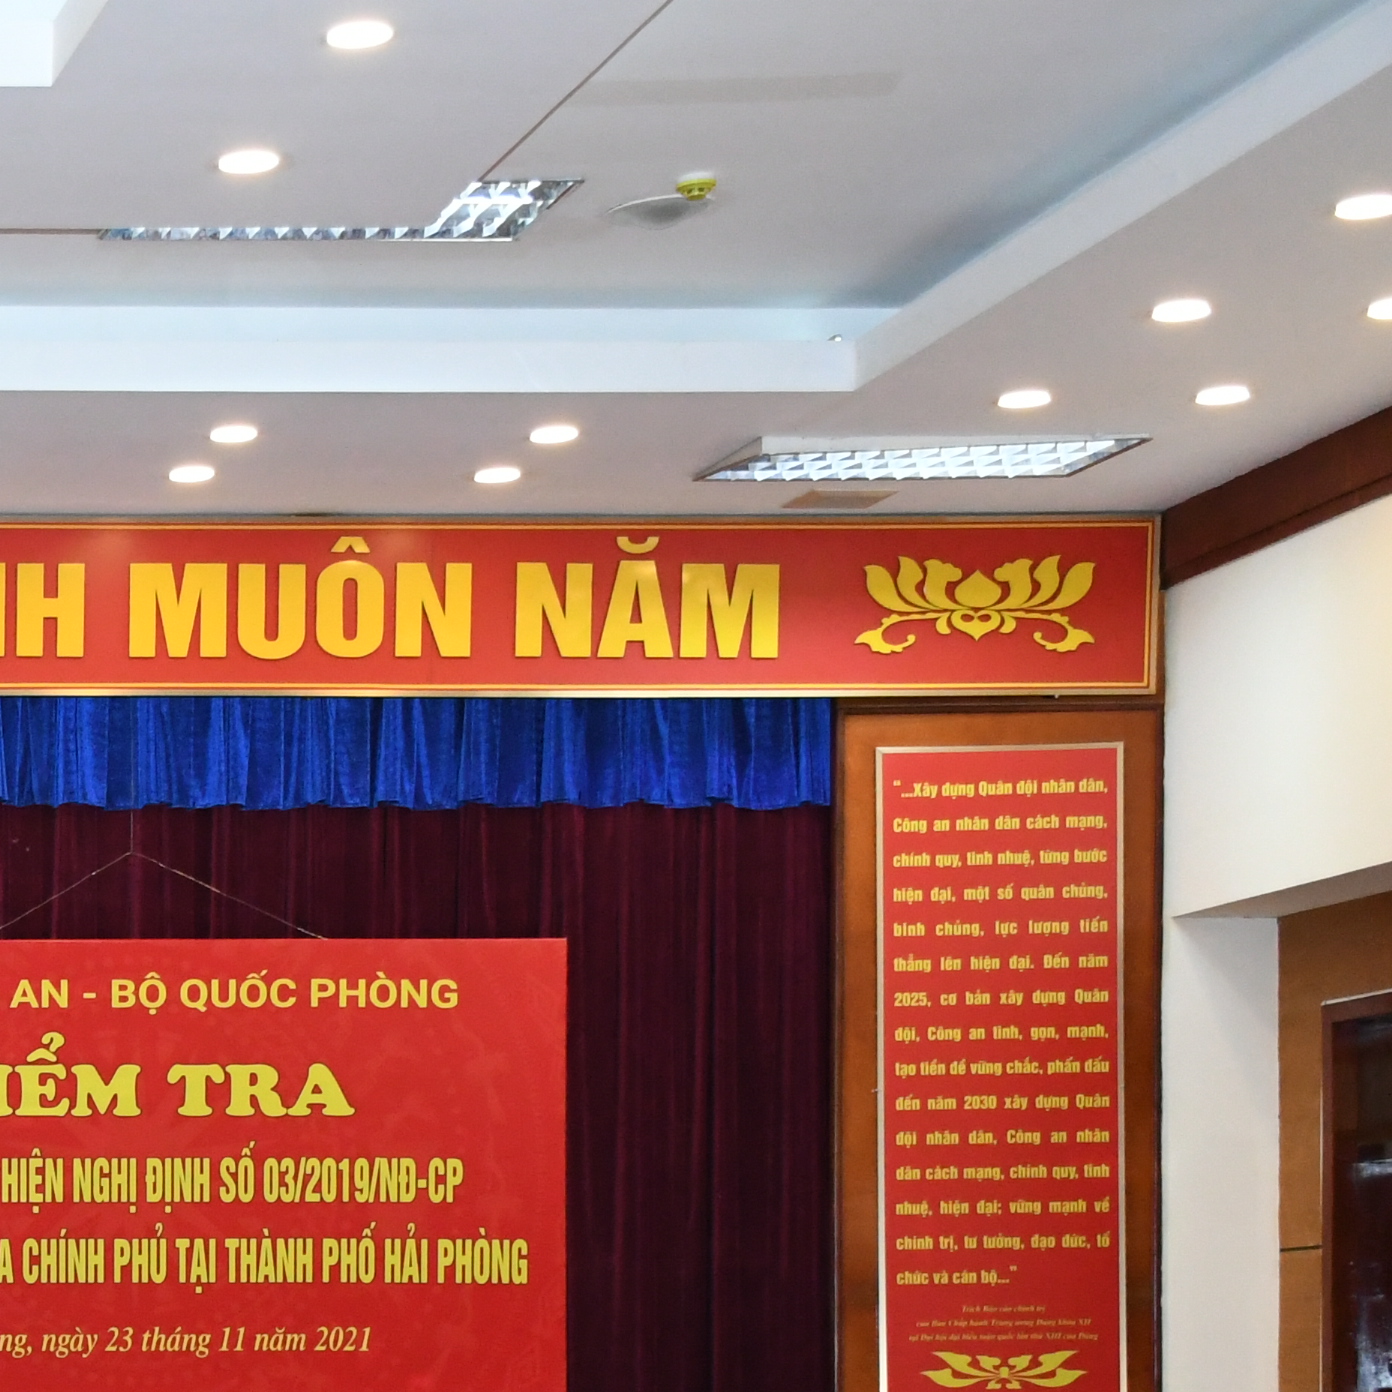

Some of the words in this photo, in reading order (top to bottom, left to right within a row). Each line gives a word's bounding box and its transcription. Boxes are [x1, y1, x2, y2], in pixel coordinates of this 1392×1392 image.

[129, 537, 472, 659] MUÔN
[515, 537, 779, 658] NĂM
[979, 781, 1012, 796] Quân
[1042, 779, 1075, 793] nhân
[893, 818, 927, 833] Công
[933, 820, 950, 831] an
[956, 816, 989, 831] nhân
[995, 815, 1020, 830] dân
[1026, 814, 1059, 829] cách
[967, 851, 992, 865] tinh
[10, 979, 68, 1008] AN
[112, 972, 166, 1015] BỘ
[180, 970, 296, 1012] QUỐC
[311, 971, 458, 1008] PHÒNG
[894, 992, 931, 1007] 2025,
[1000, 990, 1023, 1005] xây
[1075, 989, 1109, 1004] Quân
[167, 1063, 355, 1116] TRA
[928, 1096, 956, 1110] năm
[964, 1095, 997, 1109] 2030
[1005, 1095, 1028, 1110] xây
[1076, 1094, 1110, 1109] Quân
[2, 1148, 63, 1213] HIỆN
[73, 1157, 136, 1213] NGHỊ
[145, 1158, 210, 1213] ĐỊNH
[220, 1141, 255, 1202] SỐ
[264, 1157, 463, 1203] 03/2019/NĐ-CP
[23, 1229, 104, 1284] CHÍNH
[114, 1223, 166, 1283] PHỦ
[175, 1238, 216, 1293] TẠI
[225, 1228, 313, 1283] THÀNH
[323, 1222, 376, 1283] PHỐ
[385, 1223, 428, 1283] HẢI
[438, 1228, 528, 1284] PHÒNG
[42, 1327, 98, 1358] ngày
[105, 1327, 133, 1351] 23
[142, 1327, 211, 1358] tháng
[219, 1327, 245, 1351] 11
[254, 1327, 306, 1351] năm
[314, 1326, 370, 1351] 2021
